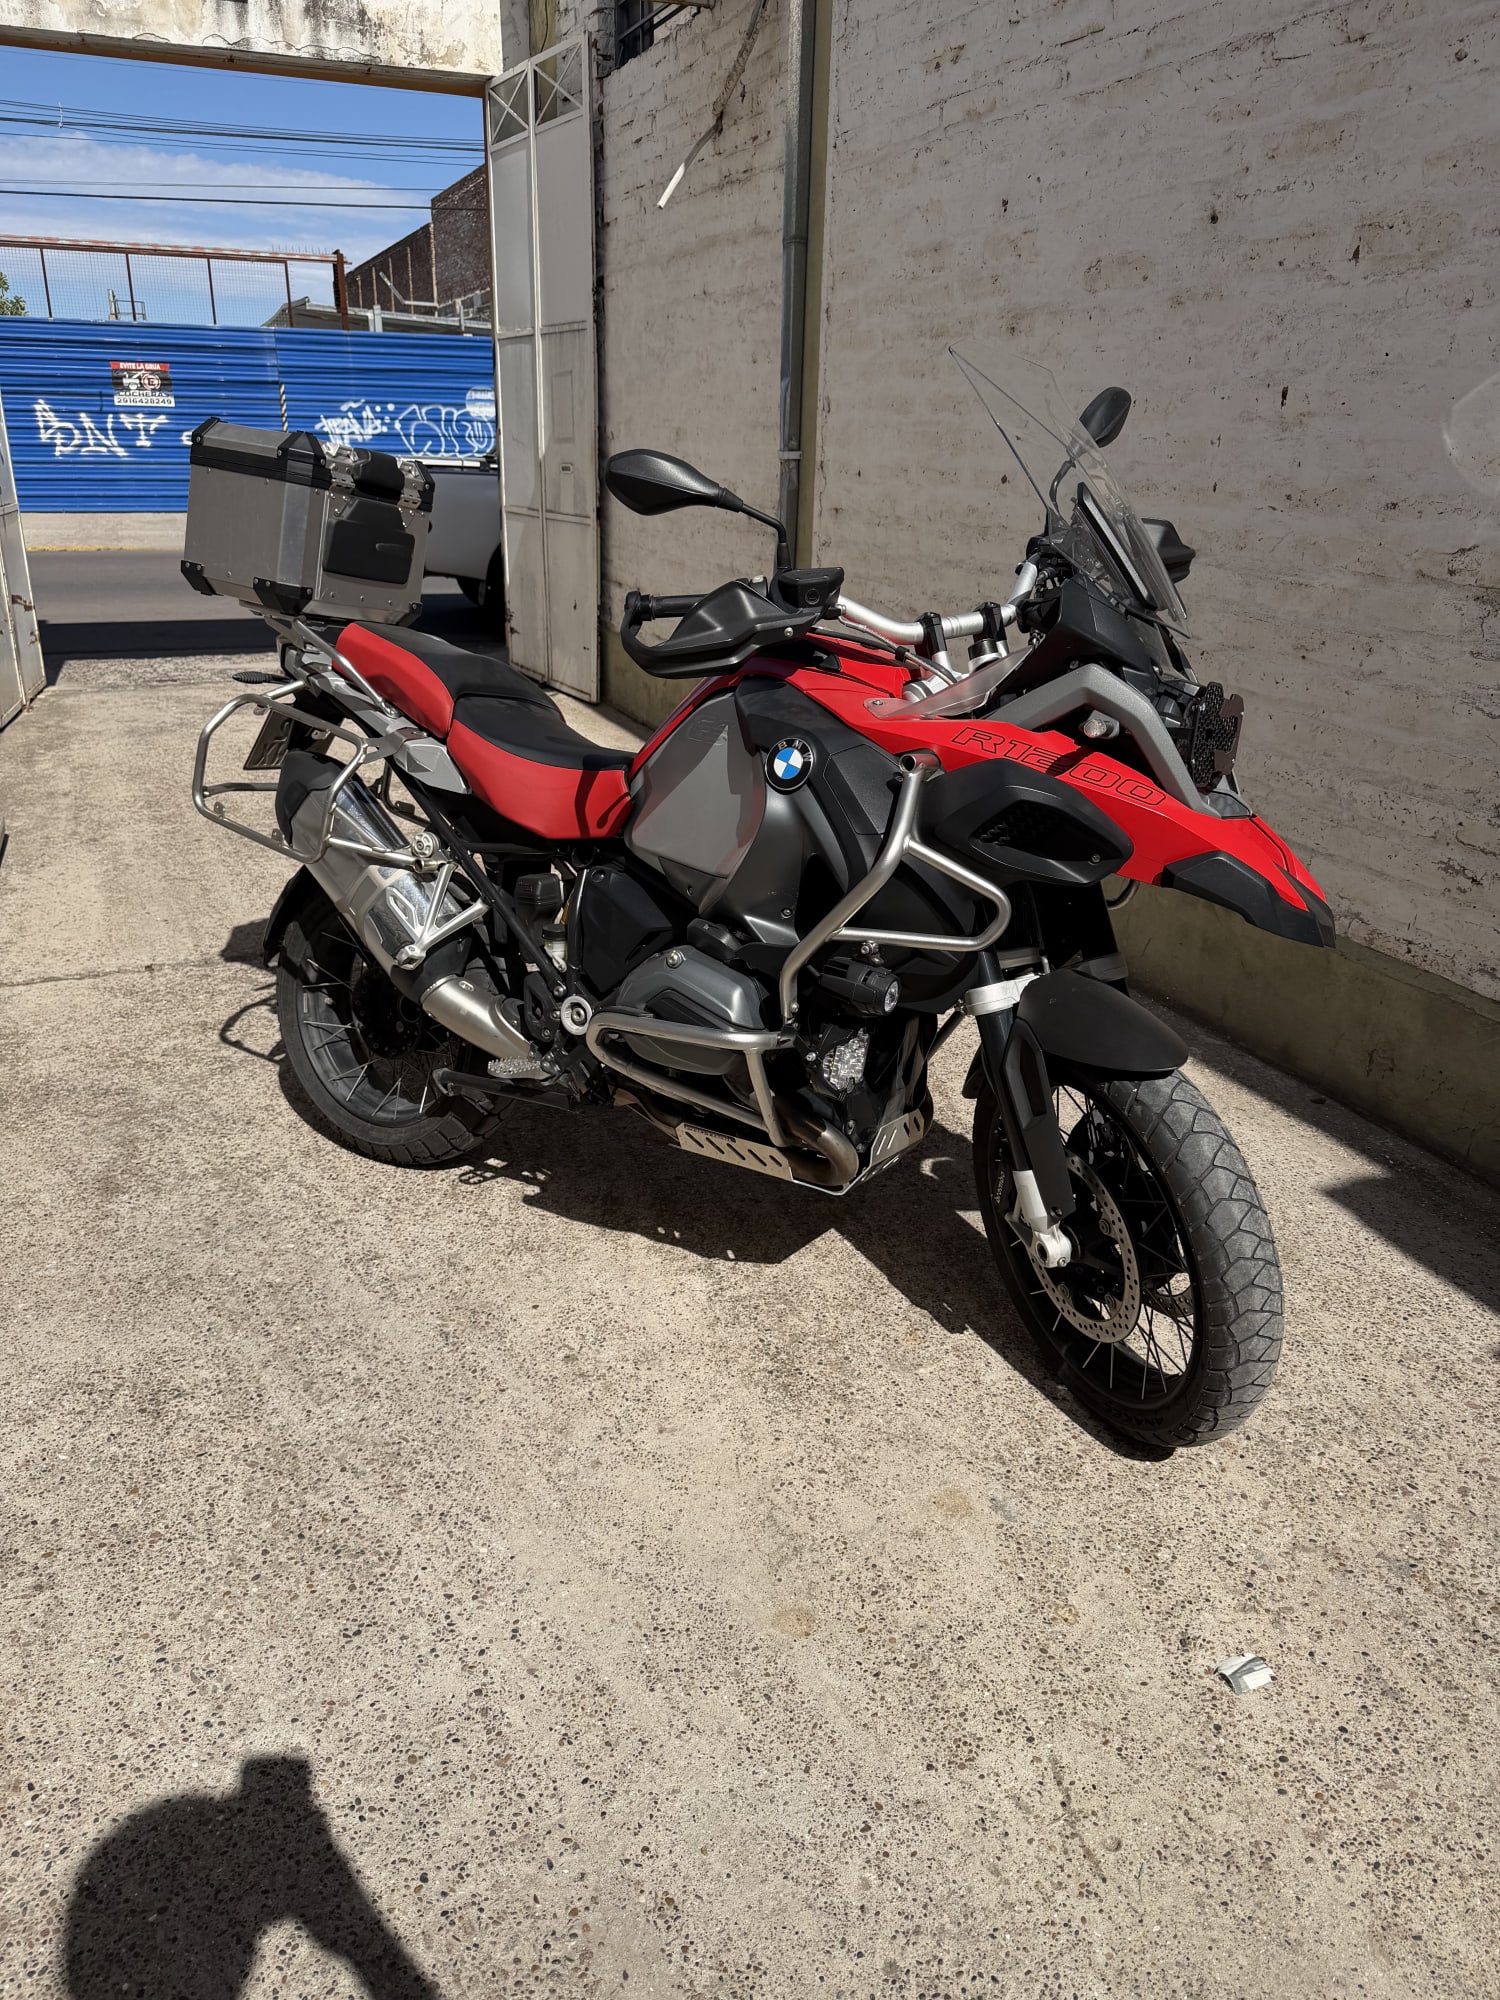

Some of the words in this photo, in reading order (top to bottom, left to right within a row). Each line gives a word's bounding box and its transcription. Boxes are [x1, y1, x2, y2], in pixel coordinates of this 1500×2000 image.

[119, 362, 136, 370] EVITE
[136, 362, 145, 370] LA
[951, 726, 1167, 806] R1200
